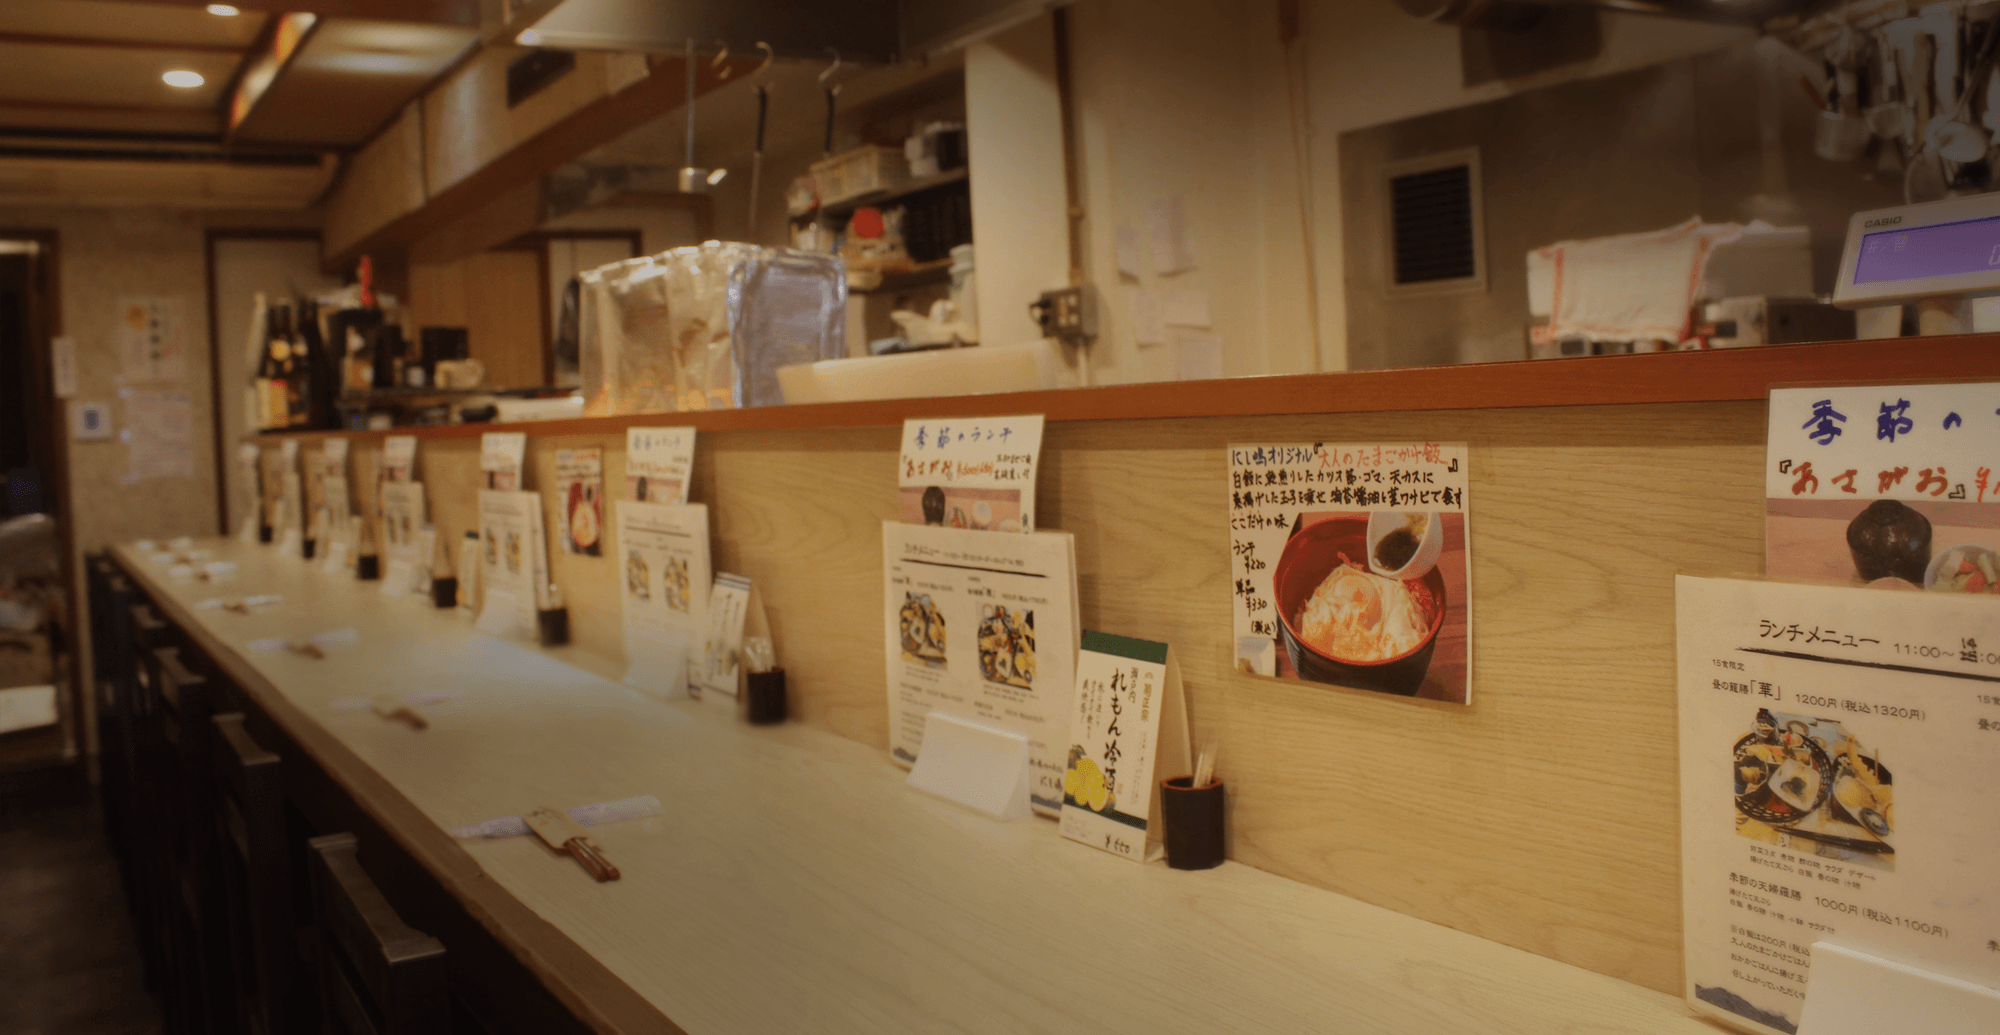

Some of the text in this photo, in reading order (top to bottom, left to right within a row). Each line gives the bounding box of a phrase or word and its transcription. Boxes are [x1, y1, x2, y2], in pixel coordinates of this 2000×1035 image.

[1864, 216, 1902, 228] CASIO
[1802, 398, 2000, 445] 季節の
[1231, 513, 1290, 530] ここだけの味
[1233, 540, 1256, 556] ランチ
[1244, 556, 1266, 575] ¥220
[1246, 597, 1268, 617] ¥330
[1759, 619, 1881, 648] ランチメニュー
[1712, 658, 1745, 672] 15食限定
[1750, 855, 1794, 874] 揚げたて天ぷら
[1824, 864, 1844, 874] サラダ
[1848, 869, 1876, 882] デザート
[1729, 872, 1802, 902] 季節の天婦羅膳
